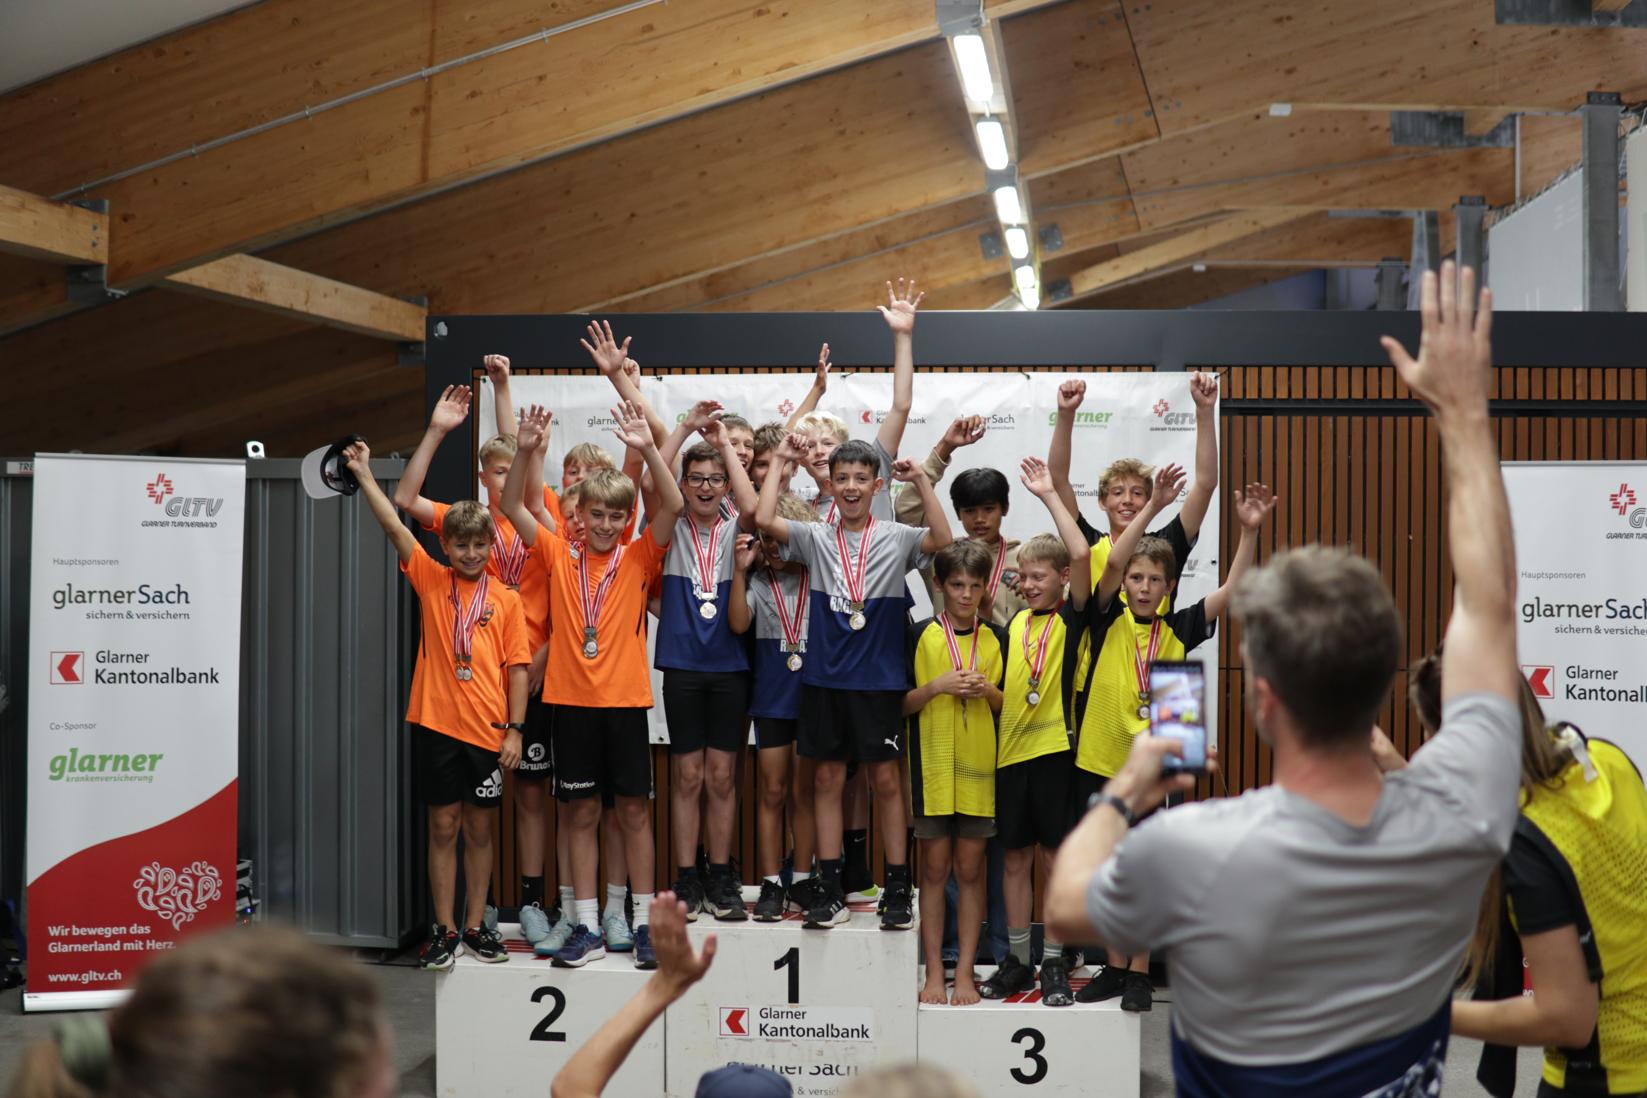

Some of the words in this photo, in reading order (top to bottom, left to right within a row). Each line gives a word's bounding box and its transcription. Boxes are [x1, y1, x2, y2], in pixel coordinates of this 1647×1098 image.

[1048, 411, 1114, 427] grner
[53, 557, 119, 566] Hauptsponsoren
[1521, 571, 1586, 579] Hauptsponsoren
[53, 583, 190, 609] glarnerSach
[86, 610, 124, 620] sichern
[126, 610, 134, 619] &
[136, 610, 190, 620] versichern
[1555, 624, 1592, 634] sichern
[1594, 625, 1601, 634] &
[96, 650, 149, 663] Glarner
[95, 667, 220, 684] Kantonalbank
[1566, 665, 1619, 680] Glarner
[50, 722, 97, 731] Co-Sponsor
[49, 748, 163, 781] glarner
[66, 774, 153, 783] krankenversicherung
[48, 925, 70, 937] Wir
[72, 926, 127, 939] bewegen
[130, 924, 150, 934] das
[48, 942, 120, 953] Glarnerland
[123, 941, 143, 950] mit
[48, 970, 122, 983] www.gltv.ch
[773, 947, 800, 1004] 1
[529, 986, 567, 1042] 2
[759, 1008, 807, 1019] Glarner
[759, 1024, 870, 1038] Kantonalbank
[1010, 1027, 1048, 1085] 3
